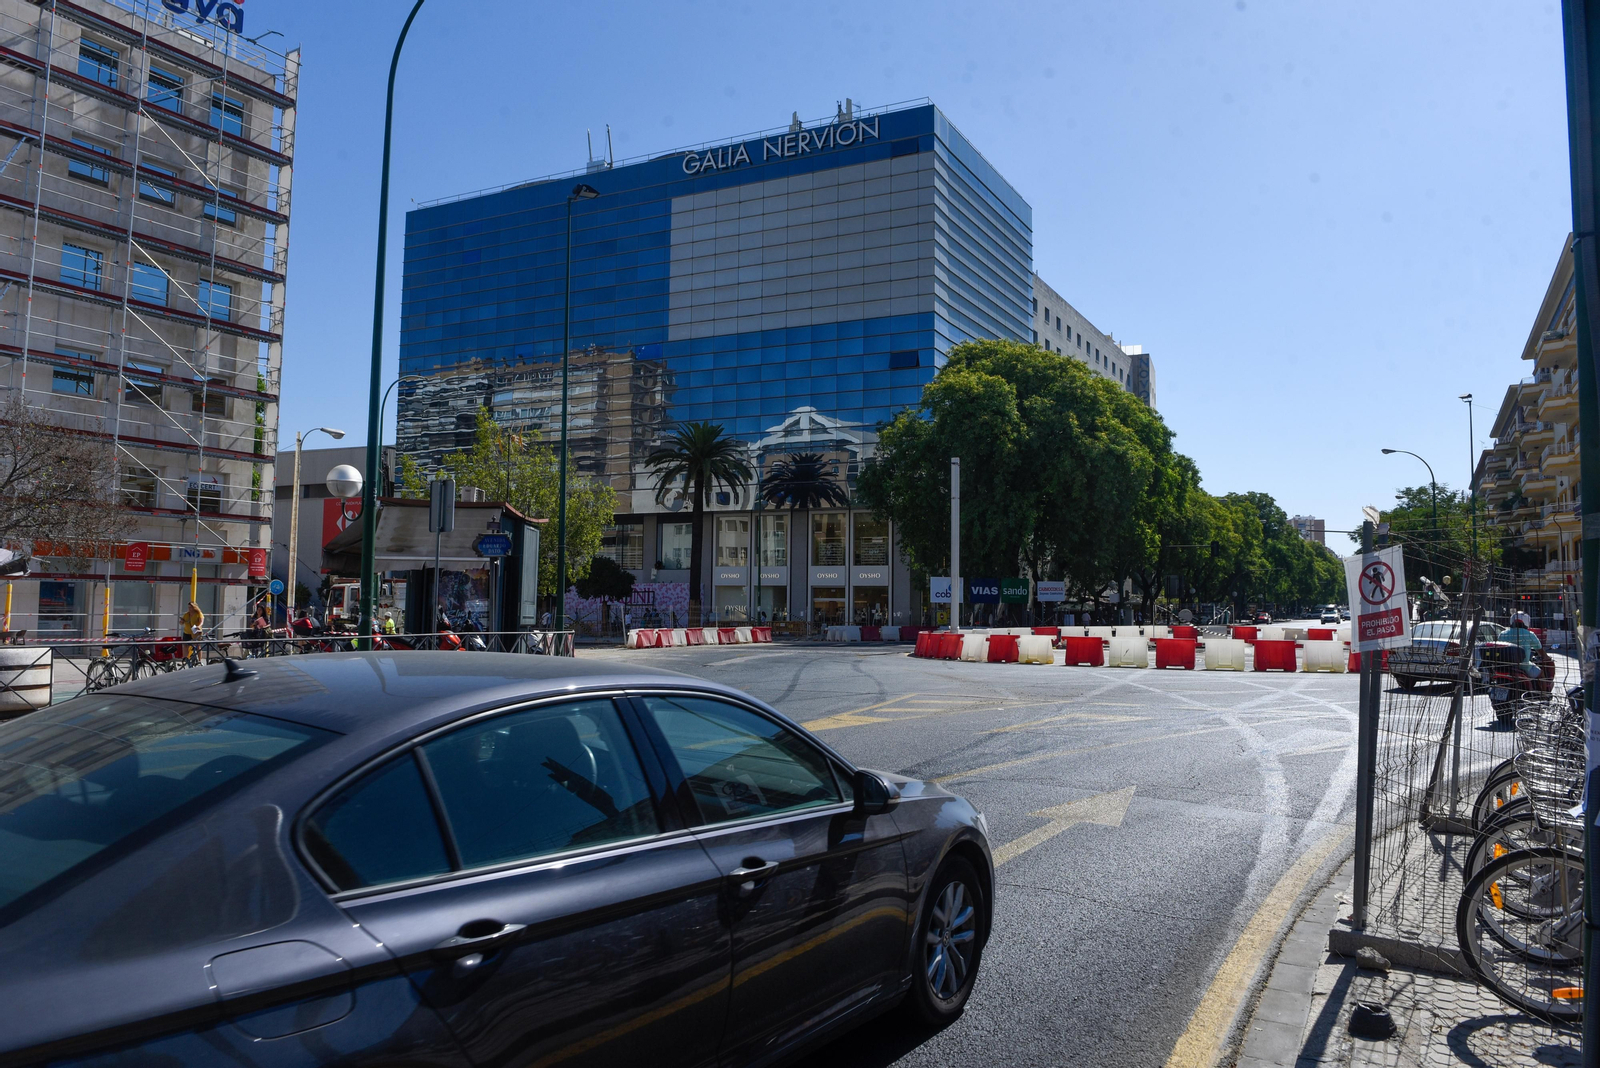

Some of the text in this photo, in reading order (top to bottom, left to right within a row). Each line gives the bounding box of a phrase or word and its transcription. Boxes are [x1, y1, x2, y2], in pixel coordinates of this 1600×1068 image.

[682, 117, 879, 175] GALIA NERVIÓN
[179, 548, 200, 558] ING
[935, 589, 951, 598] cob
[971, 586, 999, 595] VIAS
[1002, 585, 1028, 596] sando
[1362, 616, 1398, 628] PROHIBIDO
[1377, 625, 1395, 636] PASO
